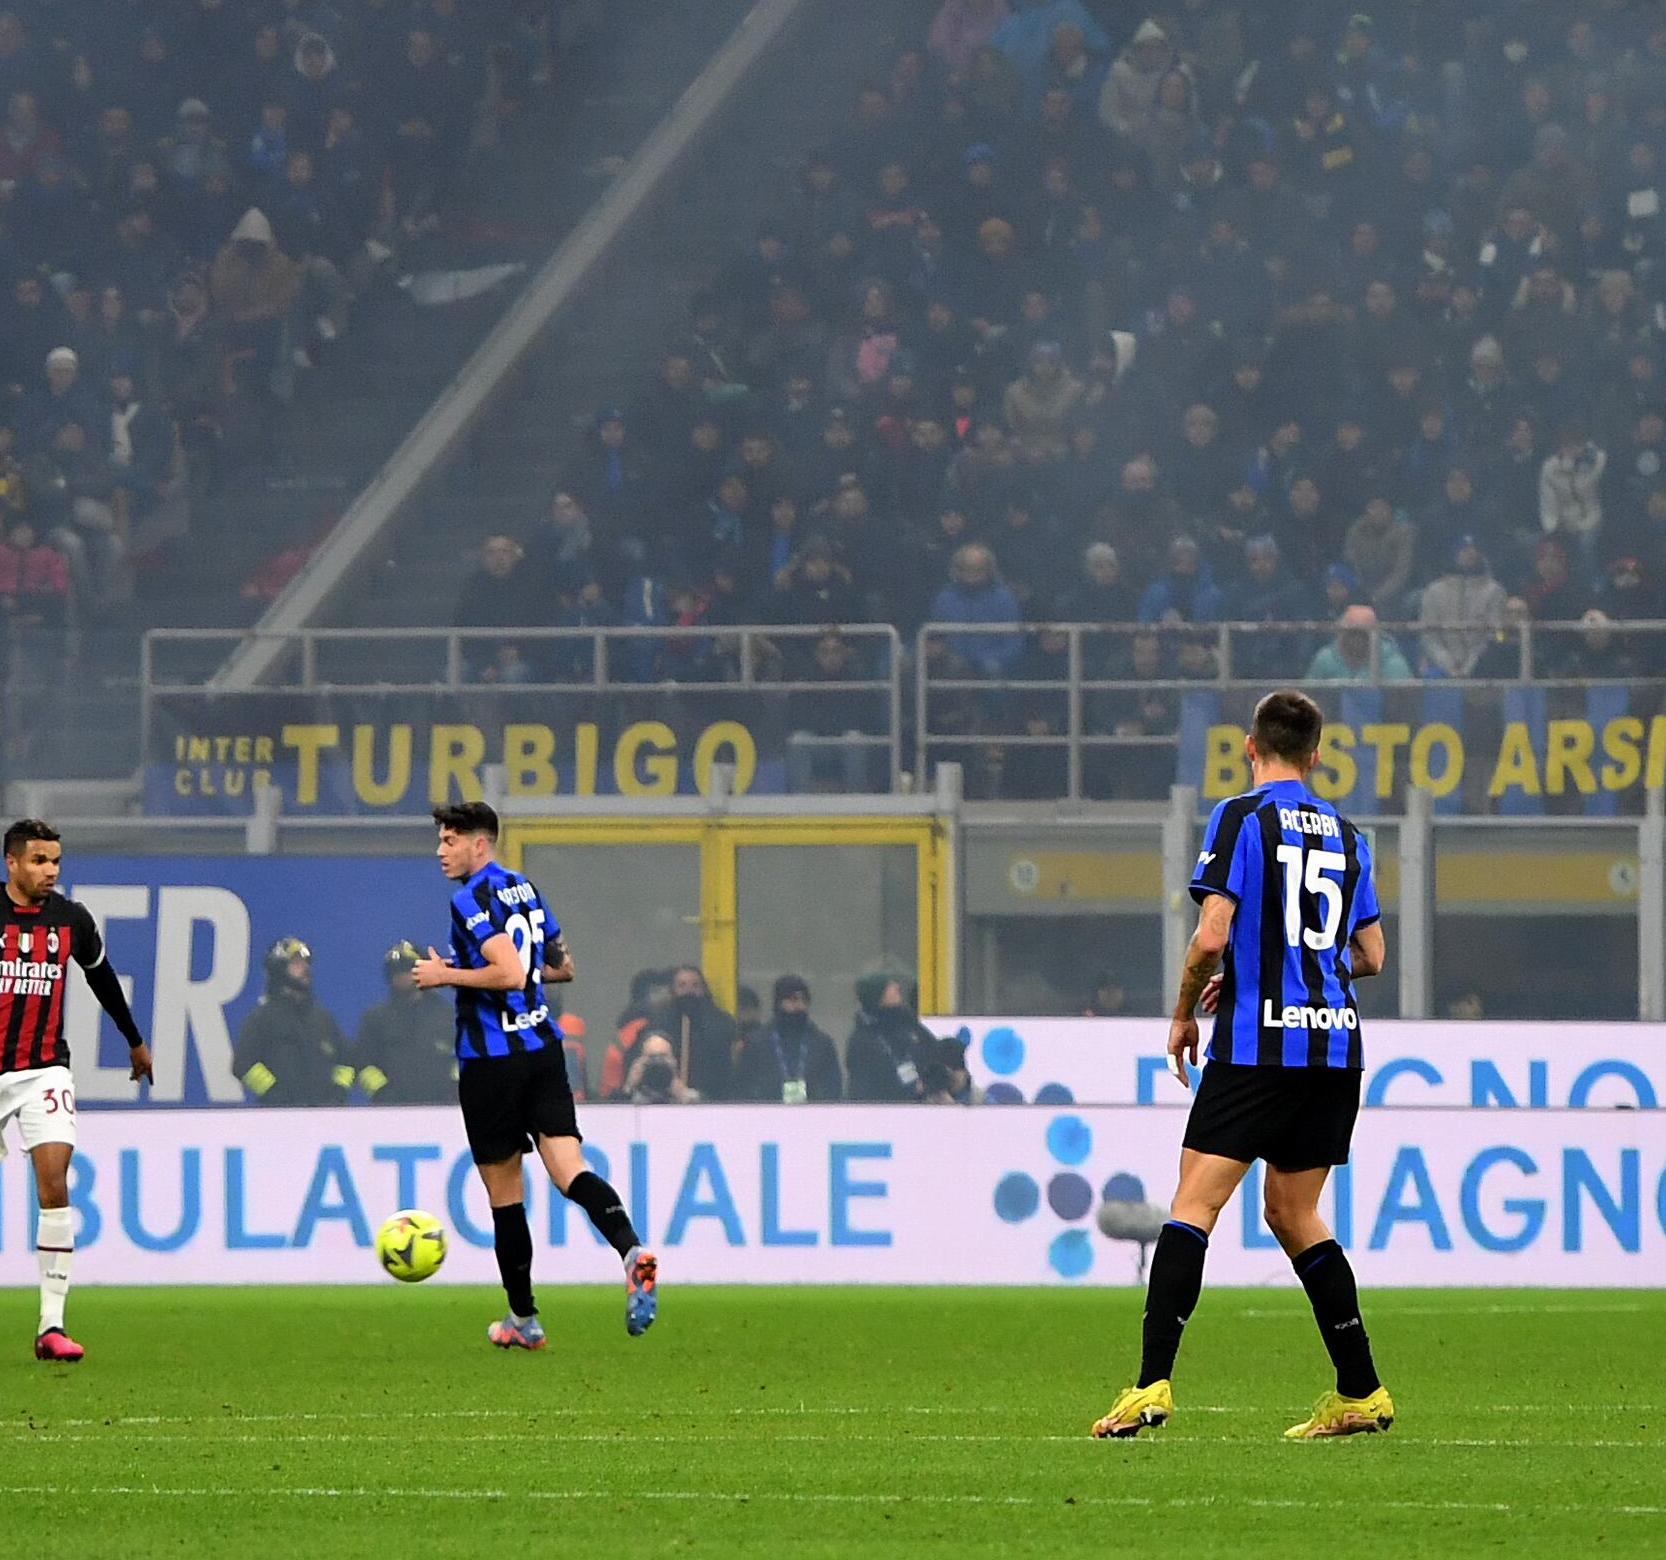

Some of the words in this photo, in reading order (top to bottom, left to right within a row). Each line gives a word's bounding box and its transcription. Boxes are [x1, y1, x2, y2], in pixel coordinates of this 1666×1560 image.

[175, 735, 274, 762] INTER
[282, 721, 757, 805] TURBIGO
[1203, 724, 1464, 798] BSTO
[1280, 807, 1338, 838] ACERBI
[1276, 844, 1346, 951] 15
[1263, 998, 1357, 1030] Lenovo
[43, 1089, 75, 1113] 30
